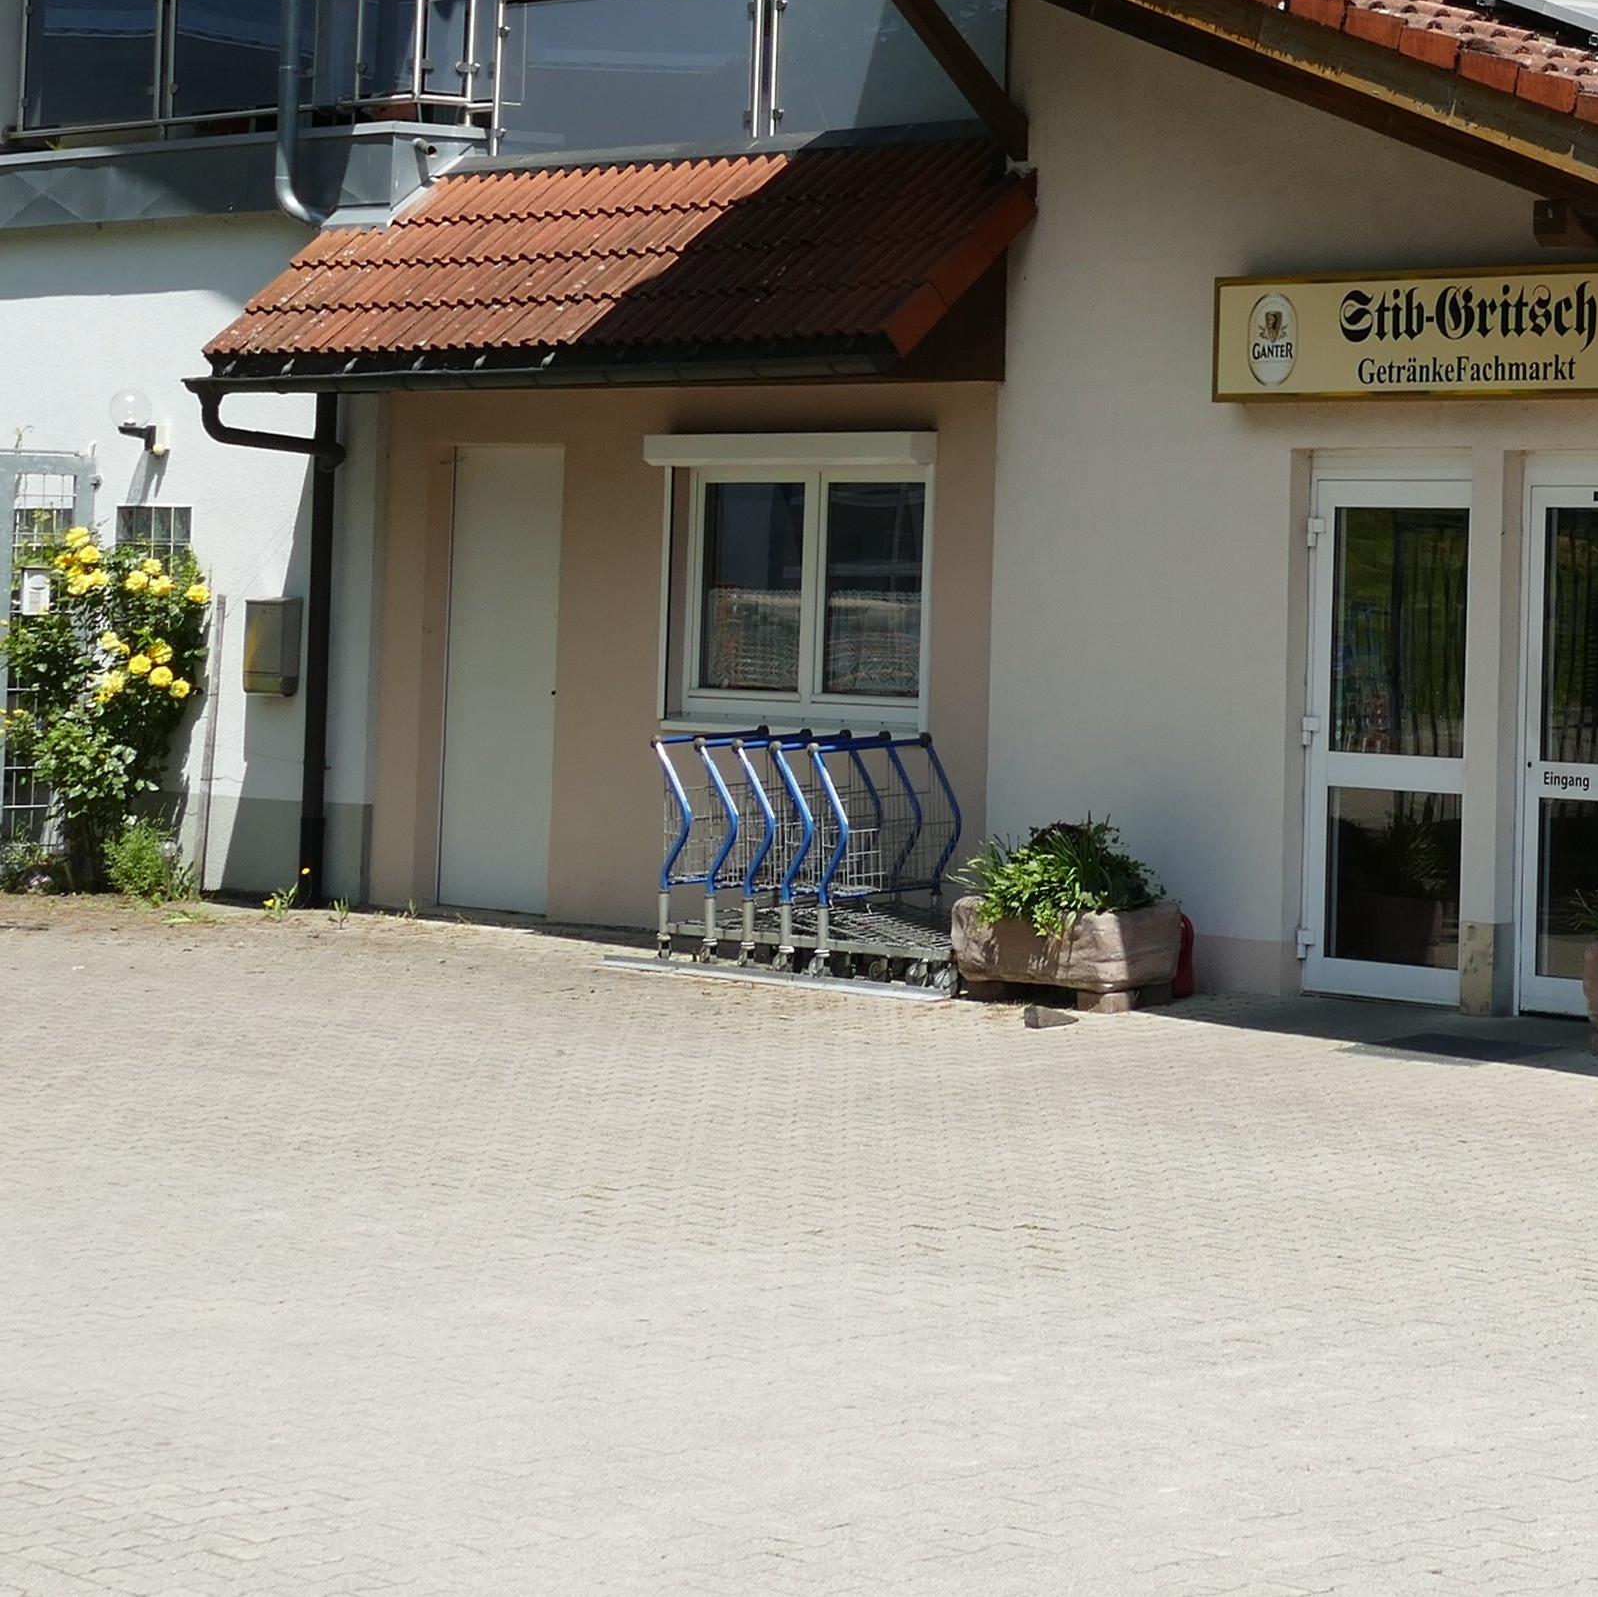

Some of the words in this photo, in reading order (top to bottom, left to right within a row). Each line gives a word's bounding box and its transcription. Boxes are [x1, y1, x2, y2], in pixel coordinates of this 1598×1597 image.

[1339, 280, 1598, 352] Stib-Gritsch
[1252, 342, 1293, 361] GANTER
[1357, 354, 1576, 386] GetränkeFachmarkt
[1542, 771, 1591, 793] Eingang
